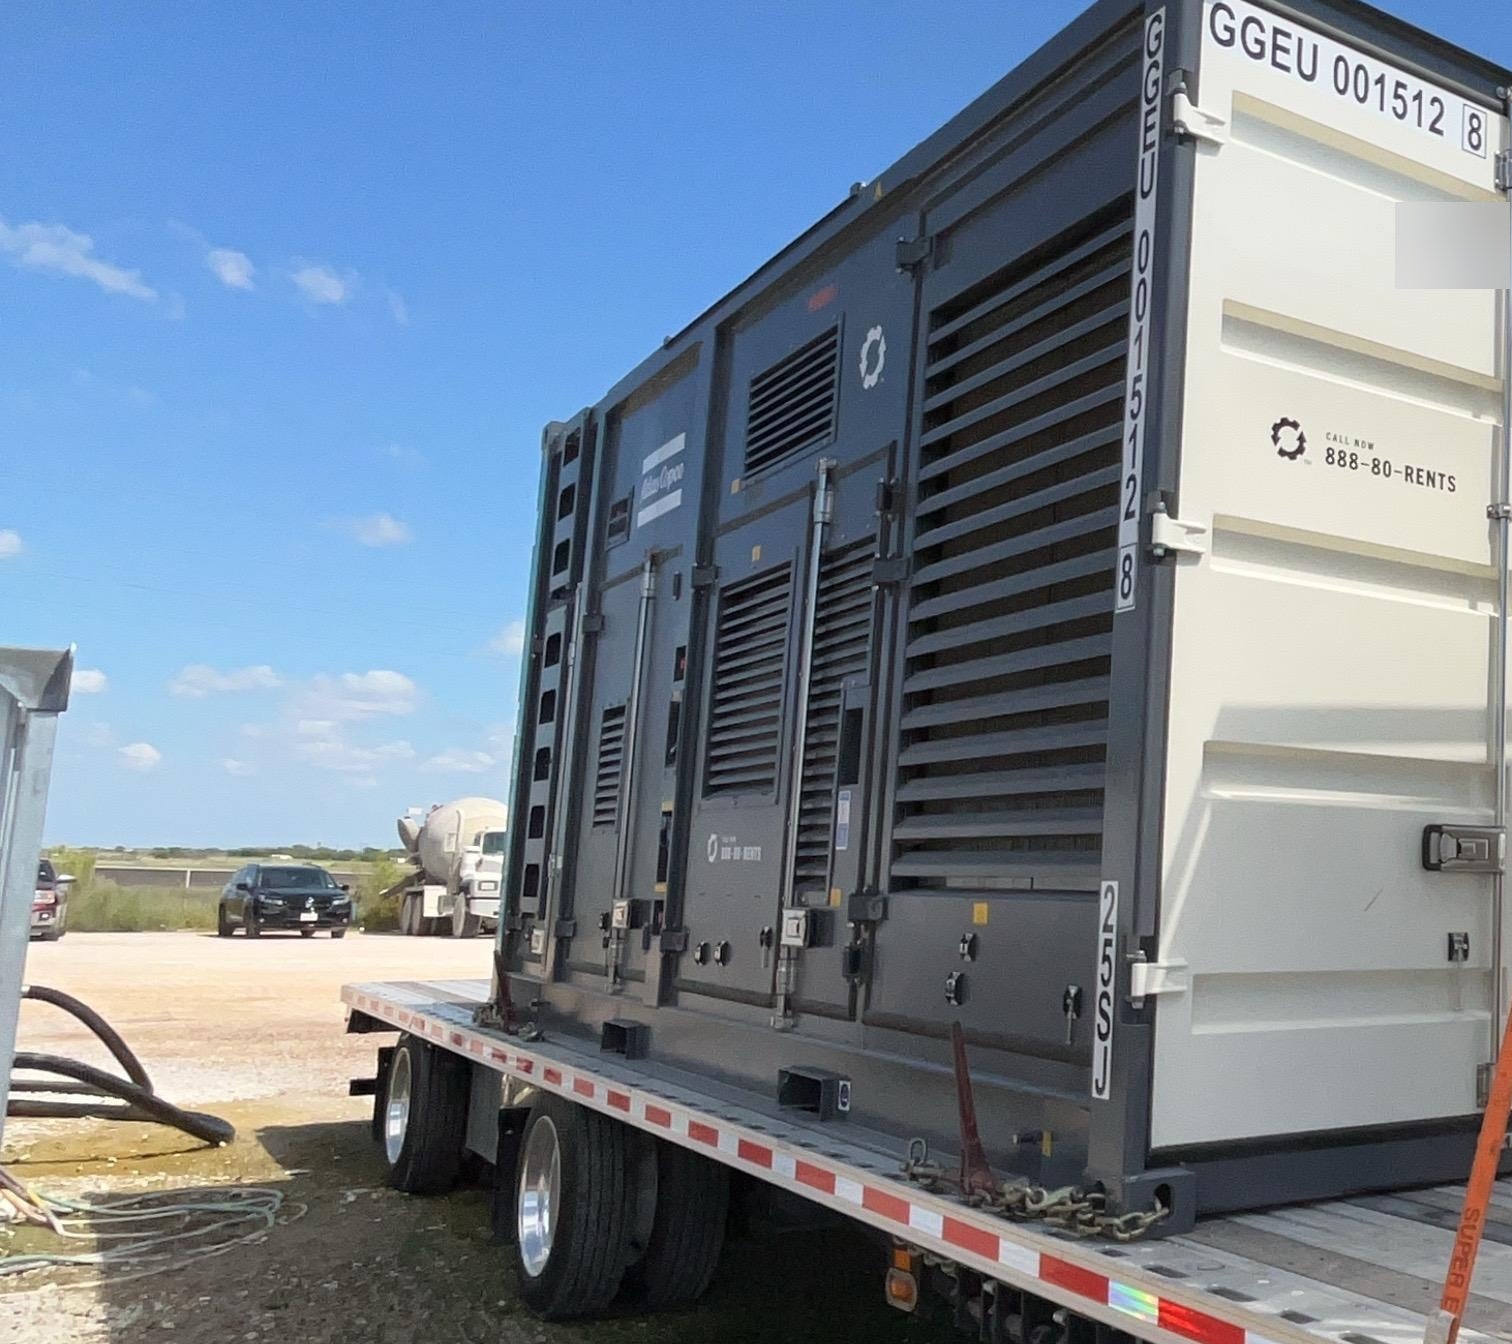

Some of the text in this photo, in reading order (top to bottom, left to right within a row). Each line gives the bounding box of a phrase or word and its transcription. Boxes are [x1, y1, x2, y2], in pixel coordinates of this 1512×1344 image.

[1209, 2, 1482, 151] GGEU 001512 8
[1119, 13, 1163, 601] GGEU 001512 8
[1325, 447, 1457, 493] 888-80-RENTS
[1326, 431, 1375, 451] CALL NOW
[1095, 883, 1116, 1096] 25SJ
[1448, 1206, 1482, 1288] SUPER
